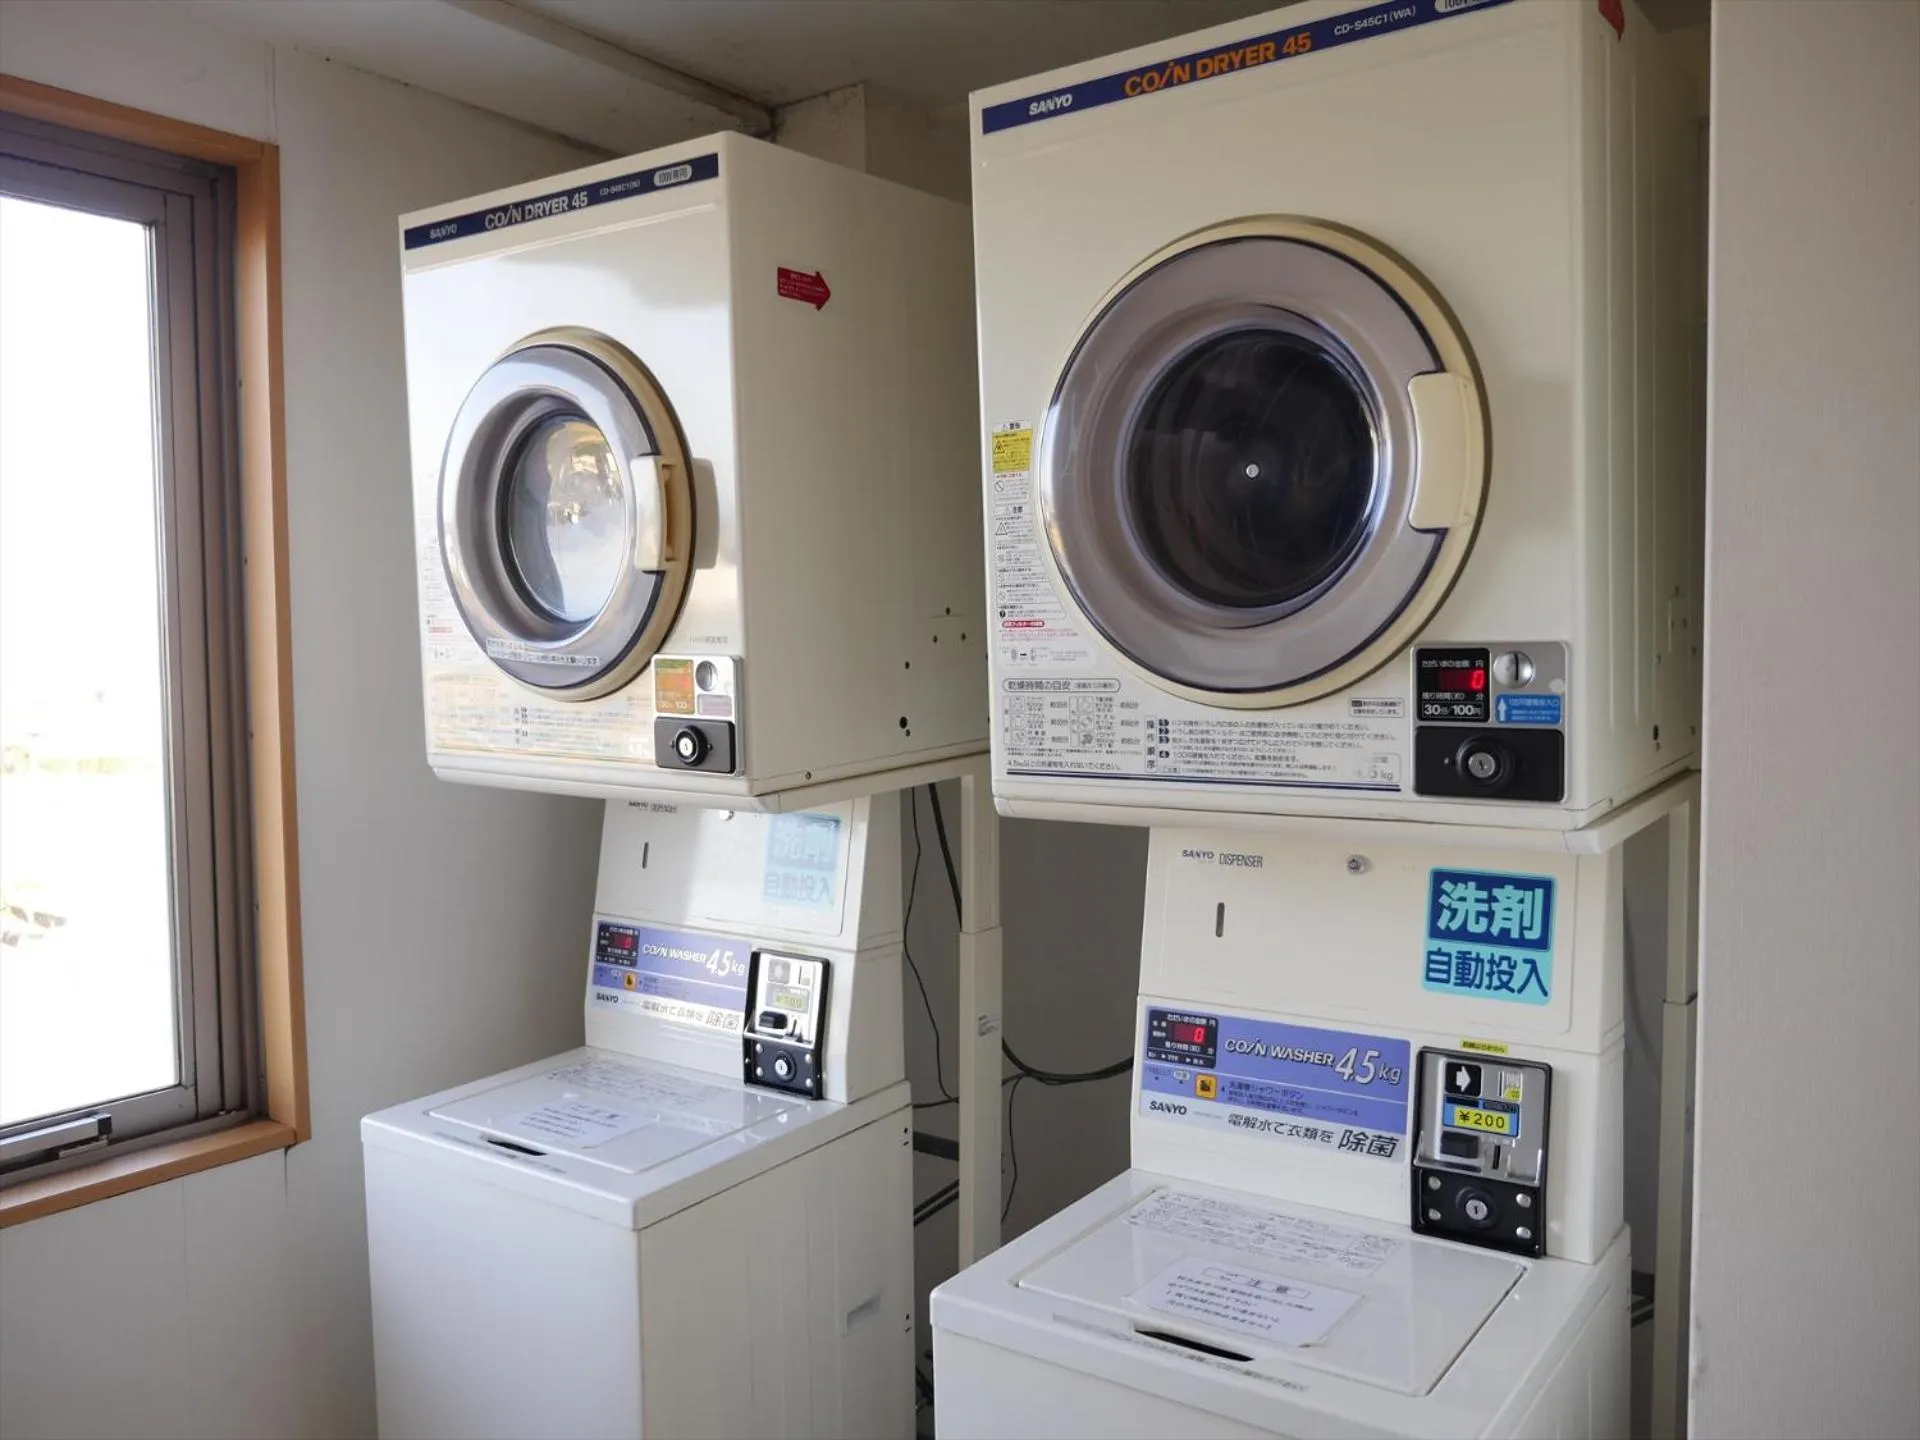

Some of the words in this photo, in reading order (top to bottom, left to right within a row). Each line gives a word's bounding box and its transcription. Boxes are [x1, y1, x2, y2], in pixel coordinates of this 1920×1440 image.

[1029, 93, 1073, 116] SANYO
[1196, 41, 1275, 79] DRYER
[1282, 31, 1312, 55] 45
[429, 223, 458, 240] SANYO
[525, 196, 569, 221] DRYER
[571, 191, 588, 209] 45
[1471, 669, 1485, 690] 0
[1182, 849, 1215, 860] SANYO
[1219, 852, 1264, 869] DISPENSER
[1437, 879, 1545, 941] 洗剤
[669, 947, 706, 963] WASHER
[1424, 946, 1549, 998] 自動投入
[1193, 1026, 1206, 1044] 0
[1270, 1045, 1335, 1067] WASHER
[1149, 1100, 1188, 1116] SANYO
[1459, 1109, 1505, 1130] ¥200
[1228, 1112, 1335, 1144] 電解水で衣類を
[1337, 1128, 1400, 1159] 除菌
